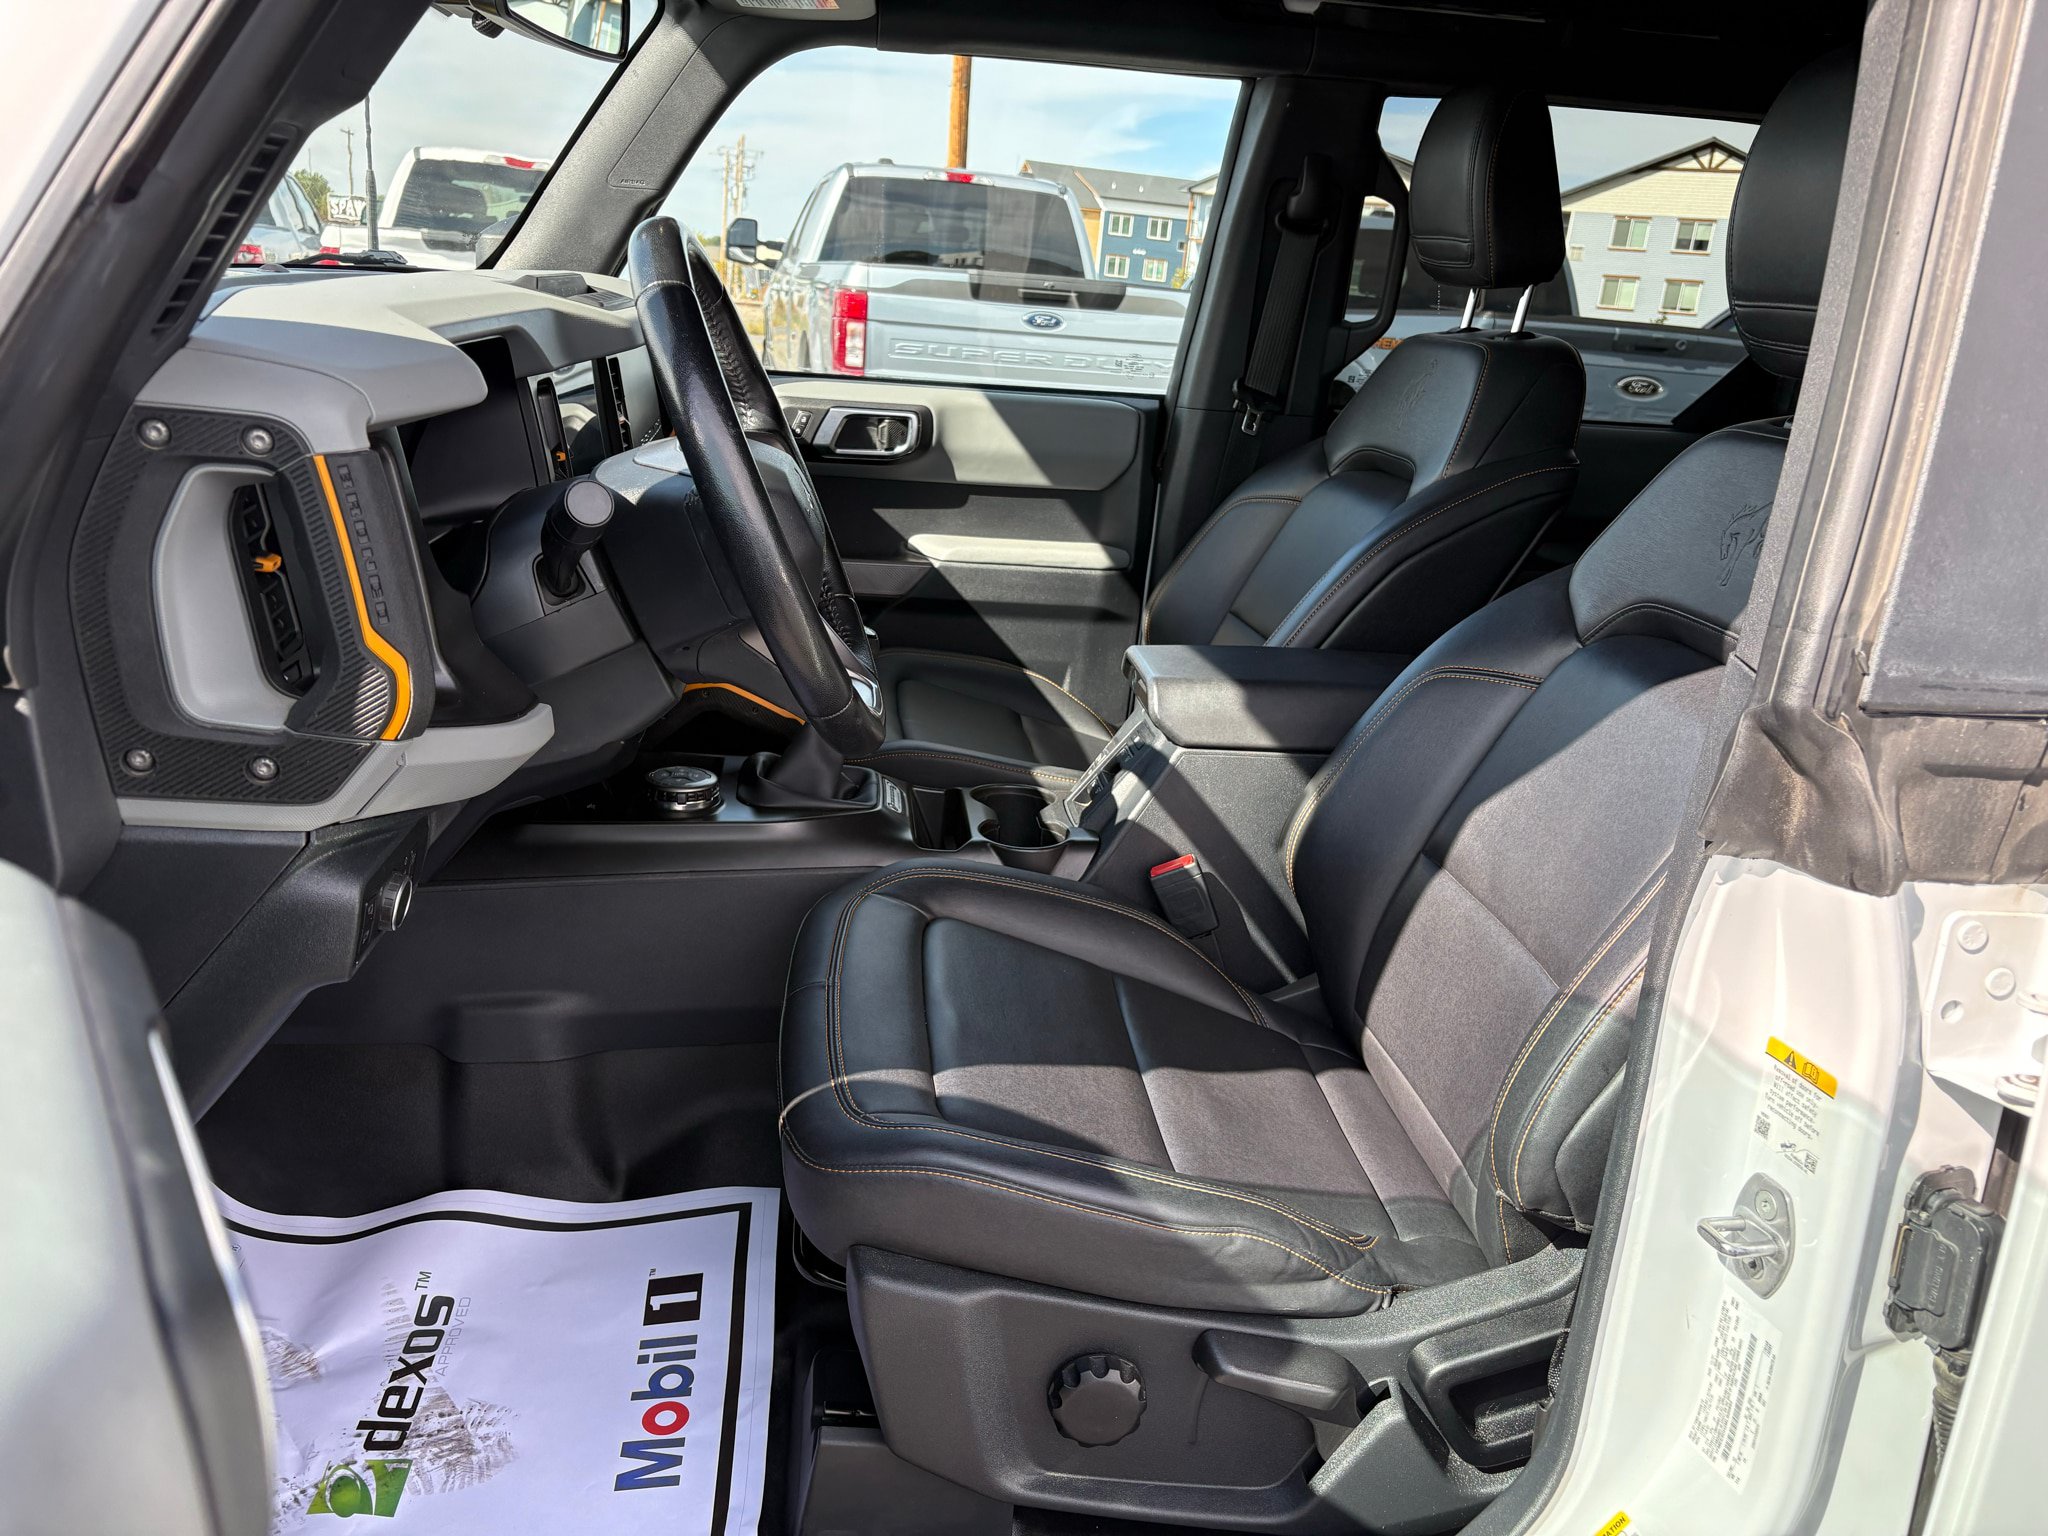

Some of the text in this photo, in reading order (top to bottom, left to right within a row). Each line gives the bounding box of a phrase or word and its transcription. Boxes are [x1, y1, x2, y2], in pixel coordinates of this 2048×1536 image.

[895, 342, 1053, 366] SUPER
[337, 464, 390, 625] BRONCO
[356, 1294, 455, 1451] dexos
[435, 1296, 472, 1377] APPROVED
[614, 1334, 698, 1492] Mobil
